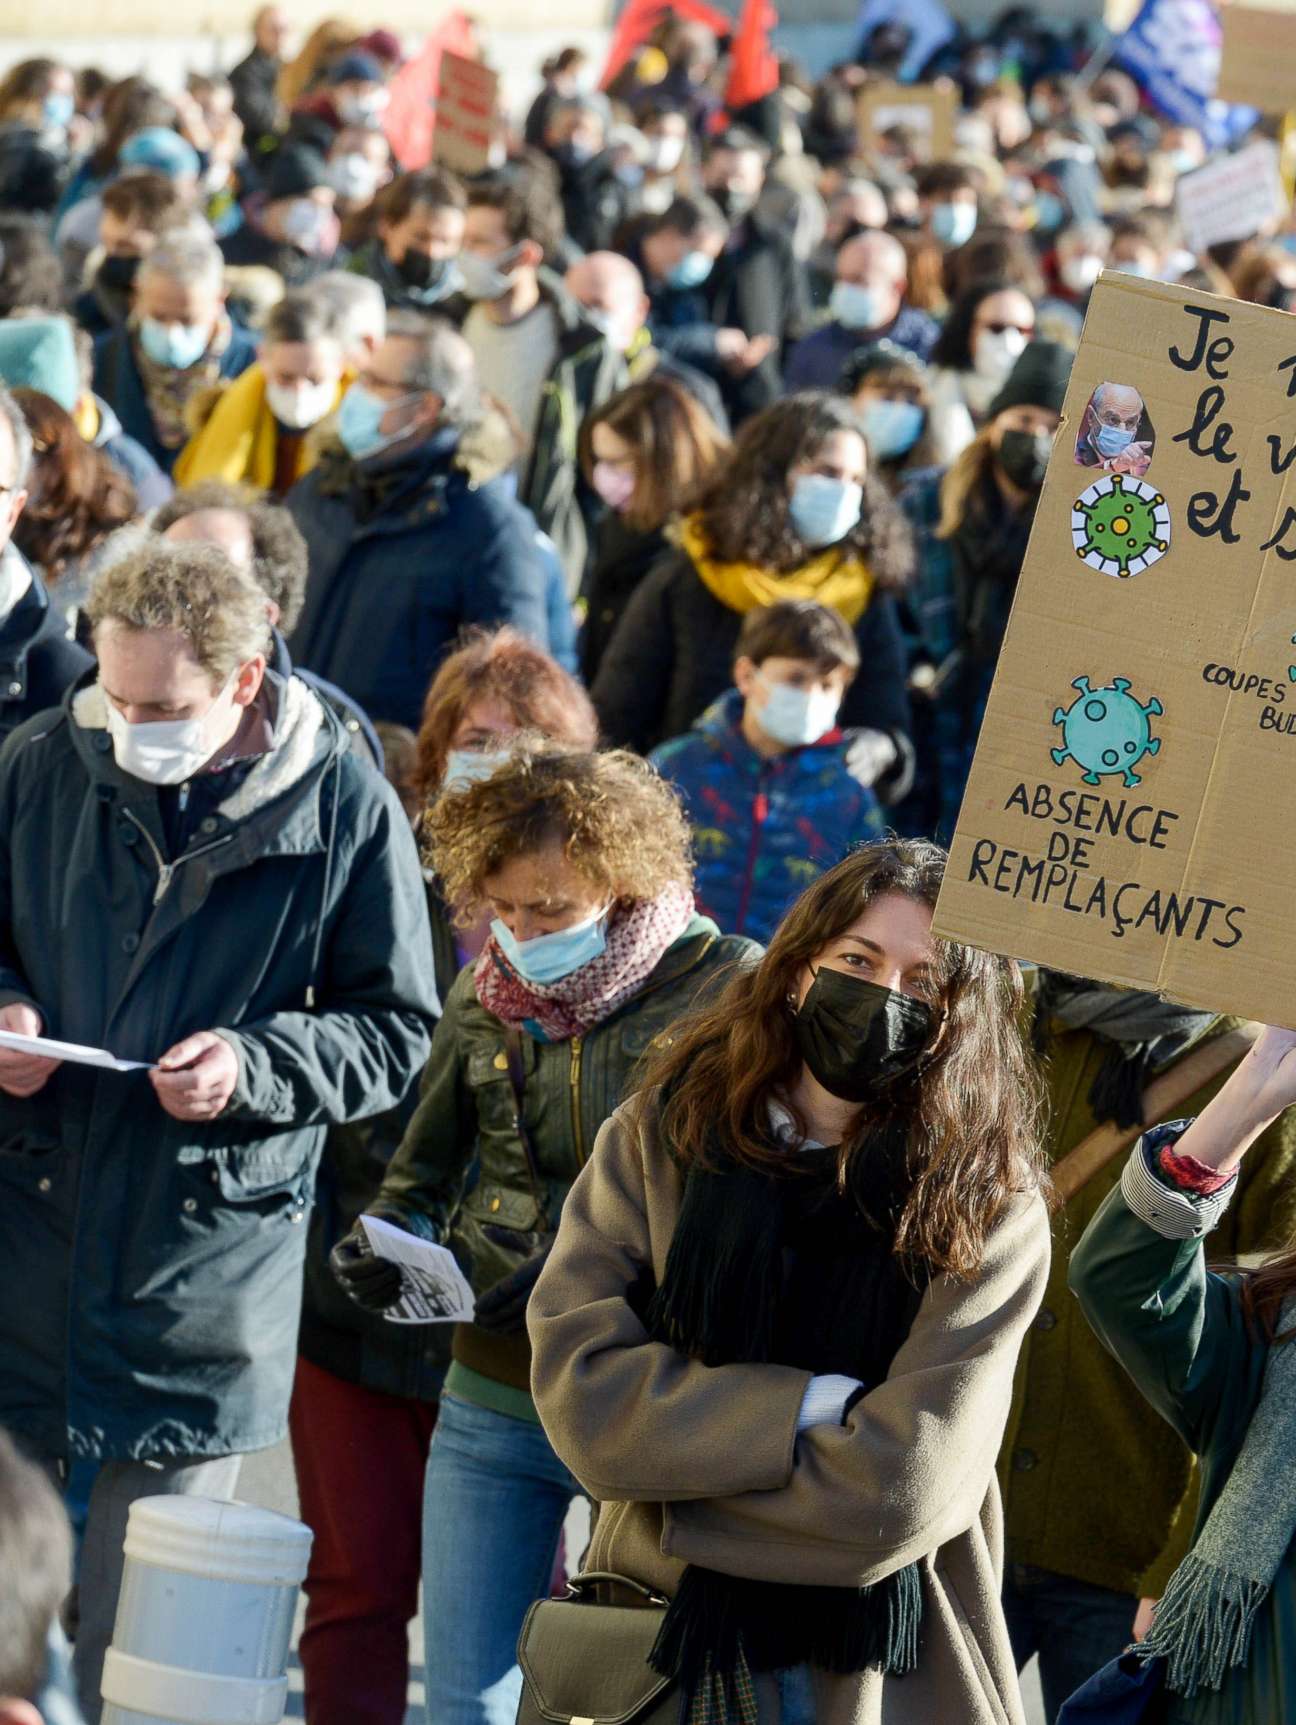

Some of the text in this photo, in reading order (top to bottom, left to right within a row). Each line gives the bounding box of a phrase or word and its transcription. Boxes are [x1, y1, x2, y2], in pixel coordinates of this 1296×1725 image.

[1168, 304, 1235, 380] Je
[1172, 384, 1237, 463] le
[1186, 467, 1251, 544] et
[1202, 662, 1287, 703] COUPES
[1003, 782, 1179, 849] ABSENCE
[1046, 831, 1095, 868] DE
[968, 838, 1245, 949] REMPLAÇANTS
